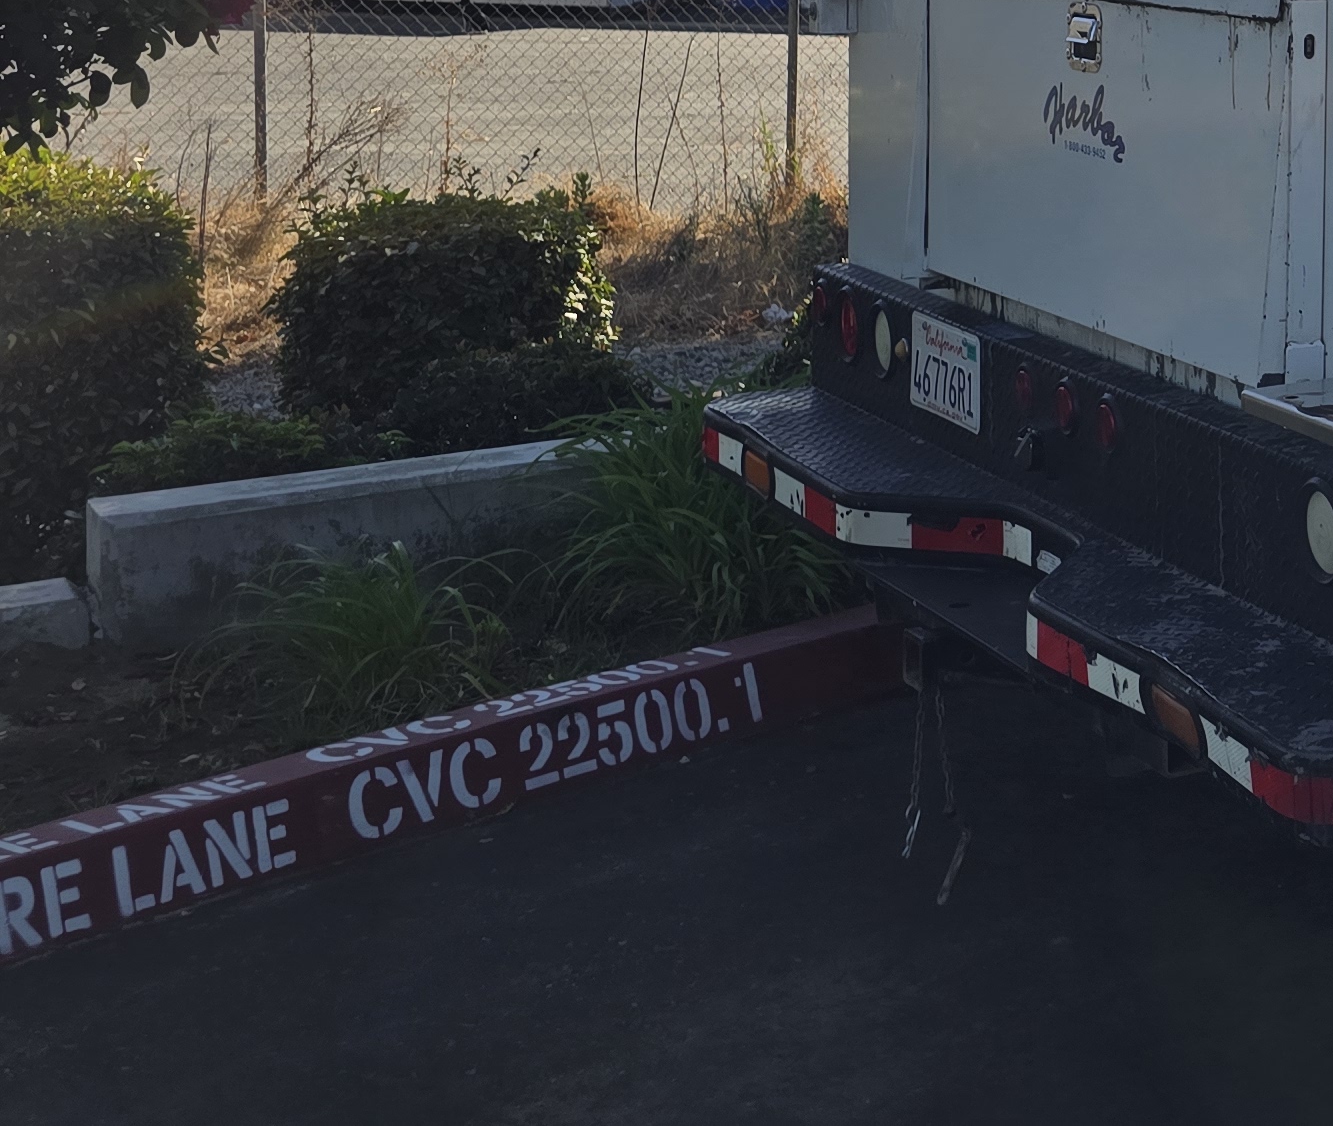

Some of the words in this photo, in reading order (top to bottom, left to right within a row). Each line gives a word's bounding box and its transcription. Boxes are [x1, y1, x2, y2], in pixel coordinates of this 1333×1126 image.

[914, 349, 974, 418] 46776R1
[60, 774, 267, 834] LANE
[306, 715, 471, 763] CVC
[473, 646, 732, 717] 22500.1
[112, 798, 296, 918] LANE
[348, 738, 502, 839] CVC
[519, 662, 763, 791] 22500.1
